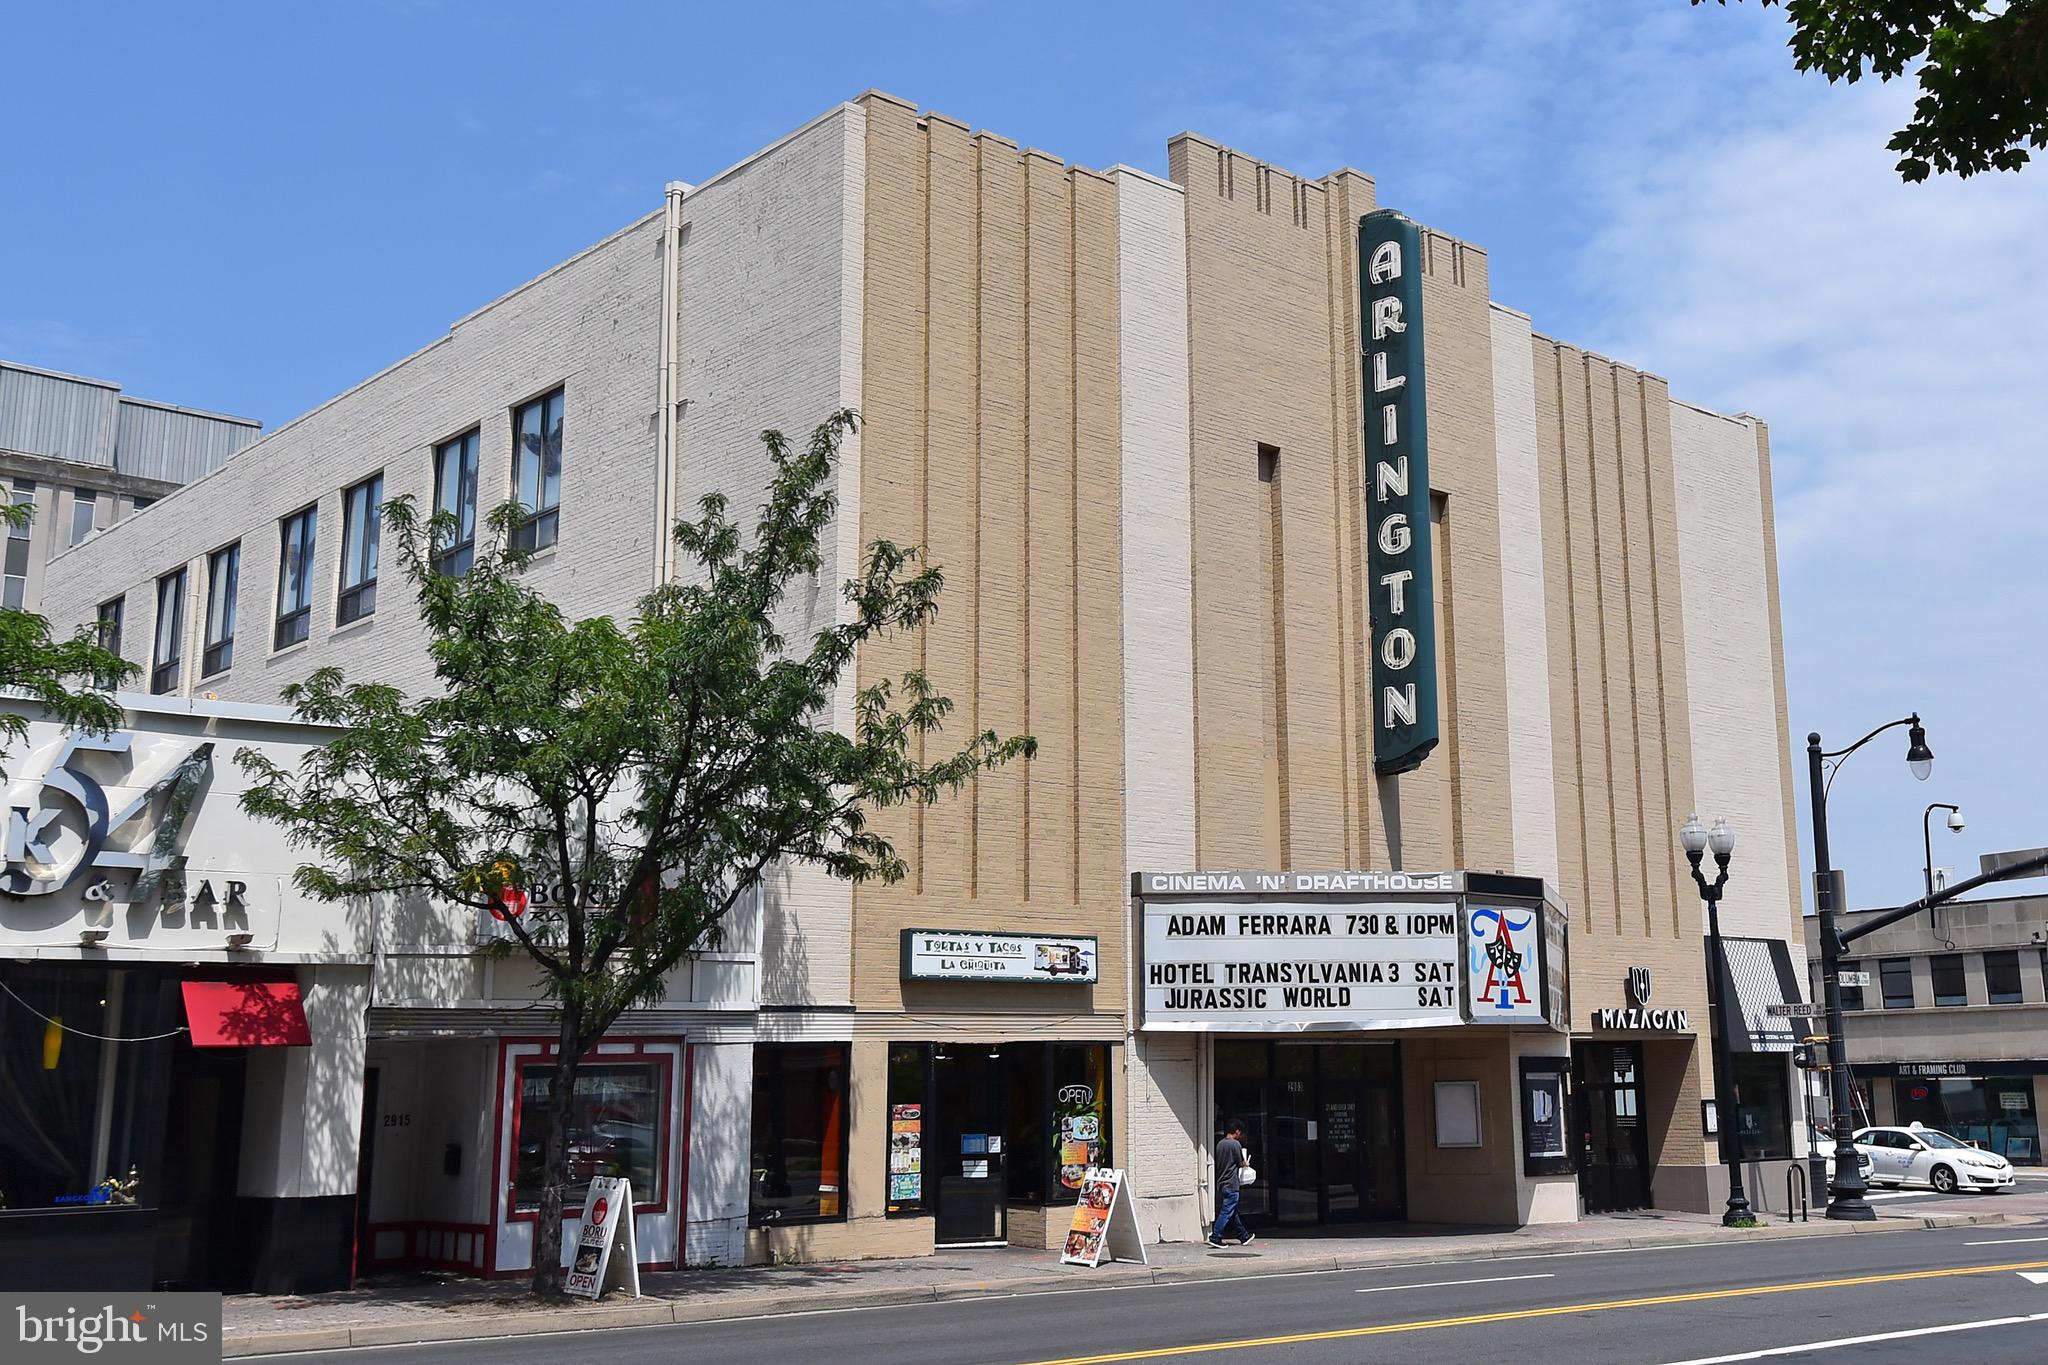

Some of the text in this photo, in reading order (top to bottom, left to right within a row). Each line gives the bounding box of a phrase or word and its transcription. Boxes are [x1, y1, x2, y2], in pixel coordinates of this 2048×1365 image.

[1369, 240, 1417, 730] ARLINGTON
[1151, 875, 1246, 890] CINEMA
[1296, 875, 1453, 890] DRAFTHOUSE
[1167, 915, 1226, 936] ADAM
[1239, 915, 1332, 936] FERRARA
[1346, 914, 1379, 935] 730
[1385, 915, 1399, 935] &
[924, 939, 1023, 955] TORTAS Y TACOS
[941, 959, 1006, 971] LA CHIQUITA
[1150, 962, 1454, 984] HOTEL TRANSYLVANIA 3 SAT
[1165, 986, 1454, 1009] JURASSIC WORLD SAT
[1601, 1008, 1689, 1030] MAZAGAN
[1766, 1005, 1791, 1017] WALTER
[1793, 1005, 1812, 1016] REED
[1899, 1064, 1966, 1075] ART & FRAMING CLUB
[1059, 1088, 1092, 1105] OPEN
[384, 1114, 411, 1127] 2915
[583, 1224, 608, 1238] BORU
[570, 1274, 596, 1290] OPEN
